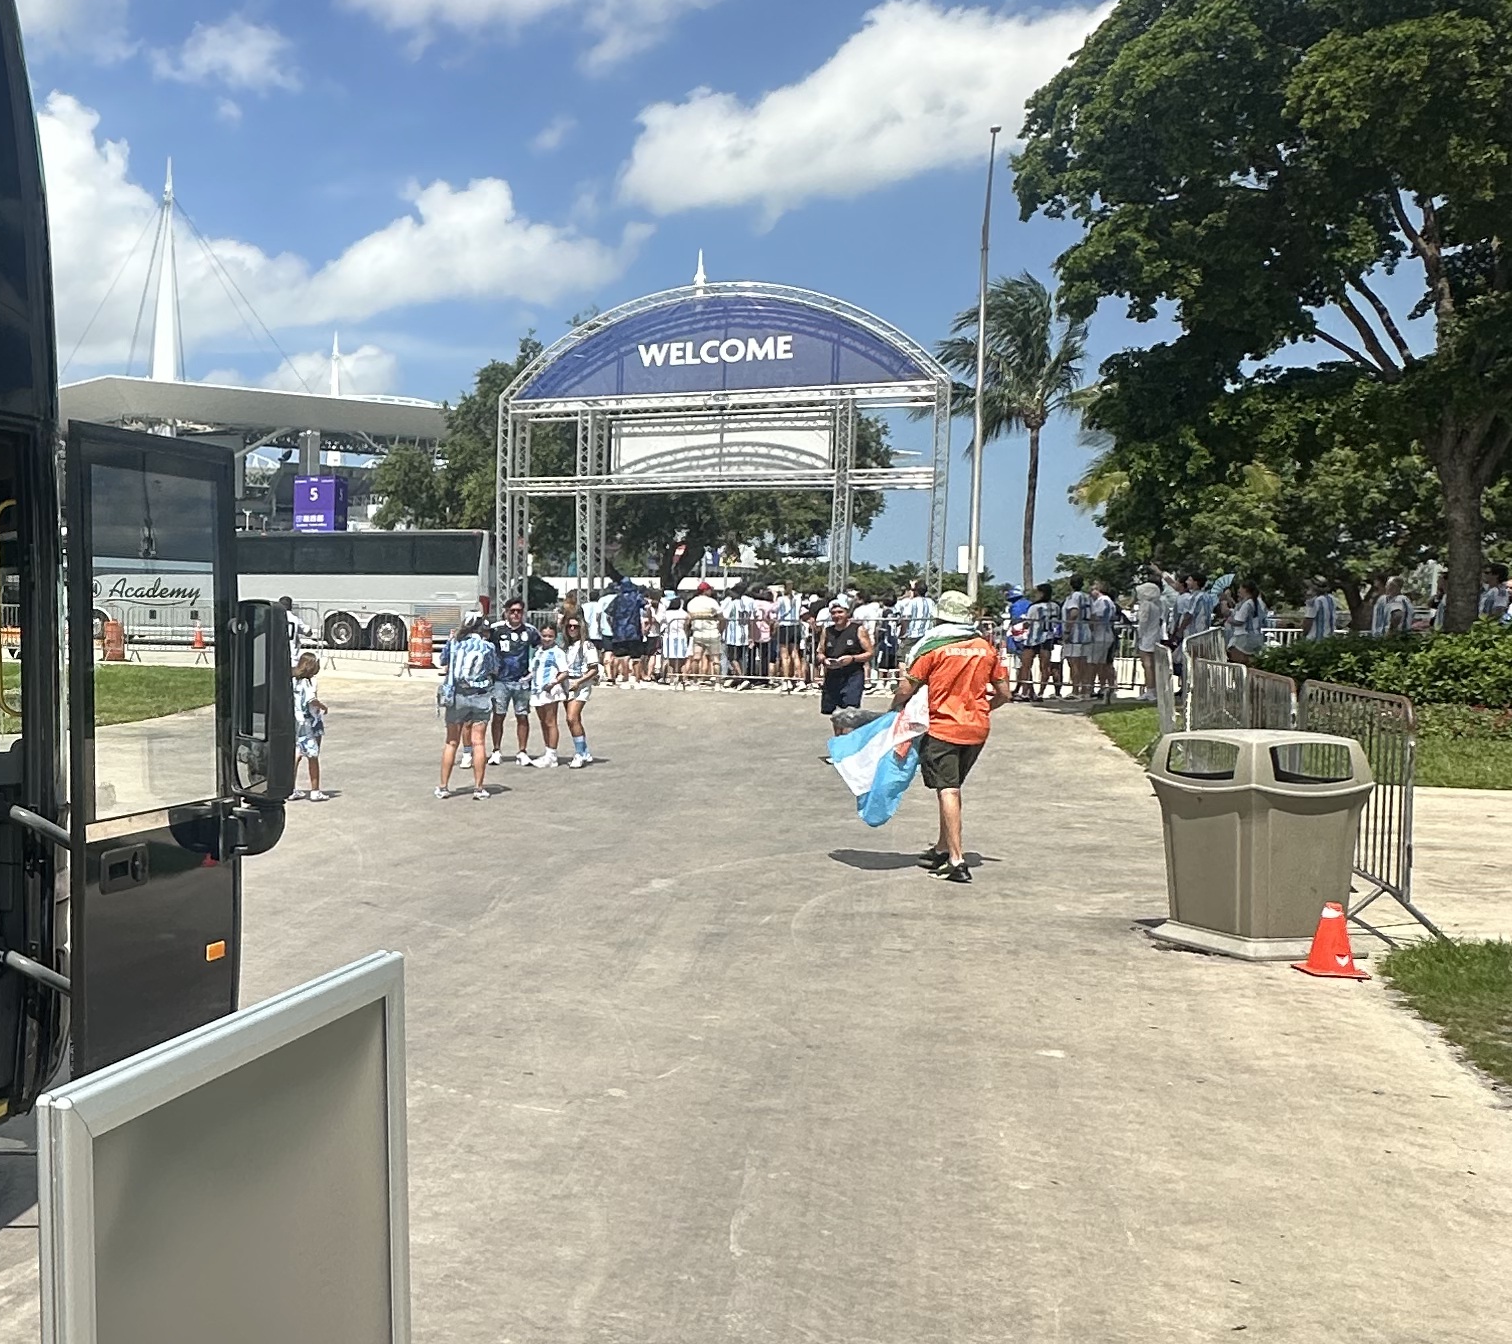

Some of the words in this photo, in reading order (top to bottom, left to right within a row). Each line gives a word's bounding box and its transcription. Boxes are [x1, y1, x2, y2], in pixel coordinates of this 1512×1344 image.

[638, 335, 794, 368] WELCOME
[309, 487, 319, 502] 5
[108, 576, 202, 607] Academy
